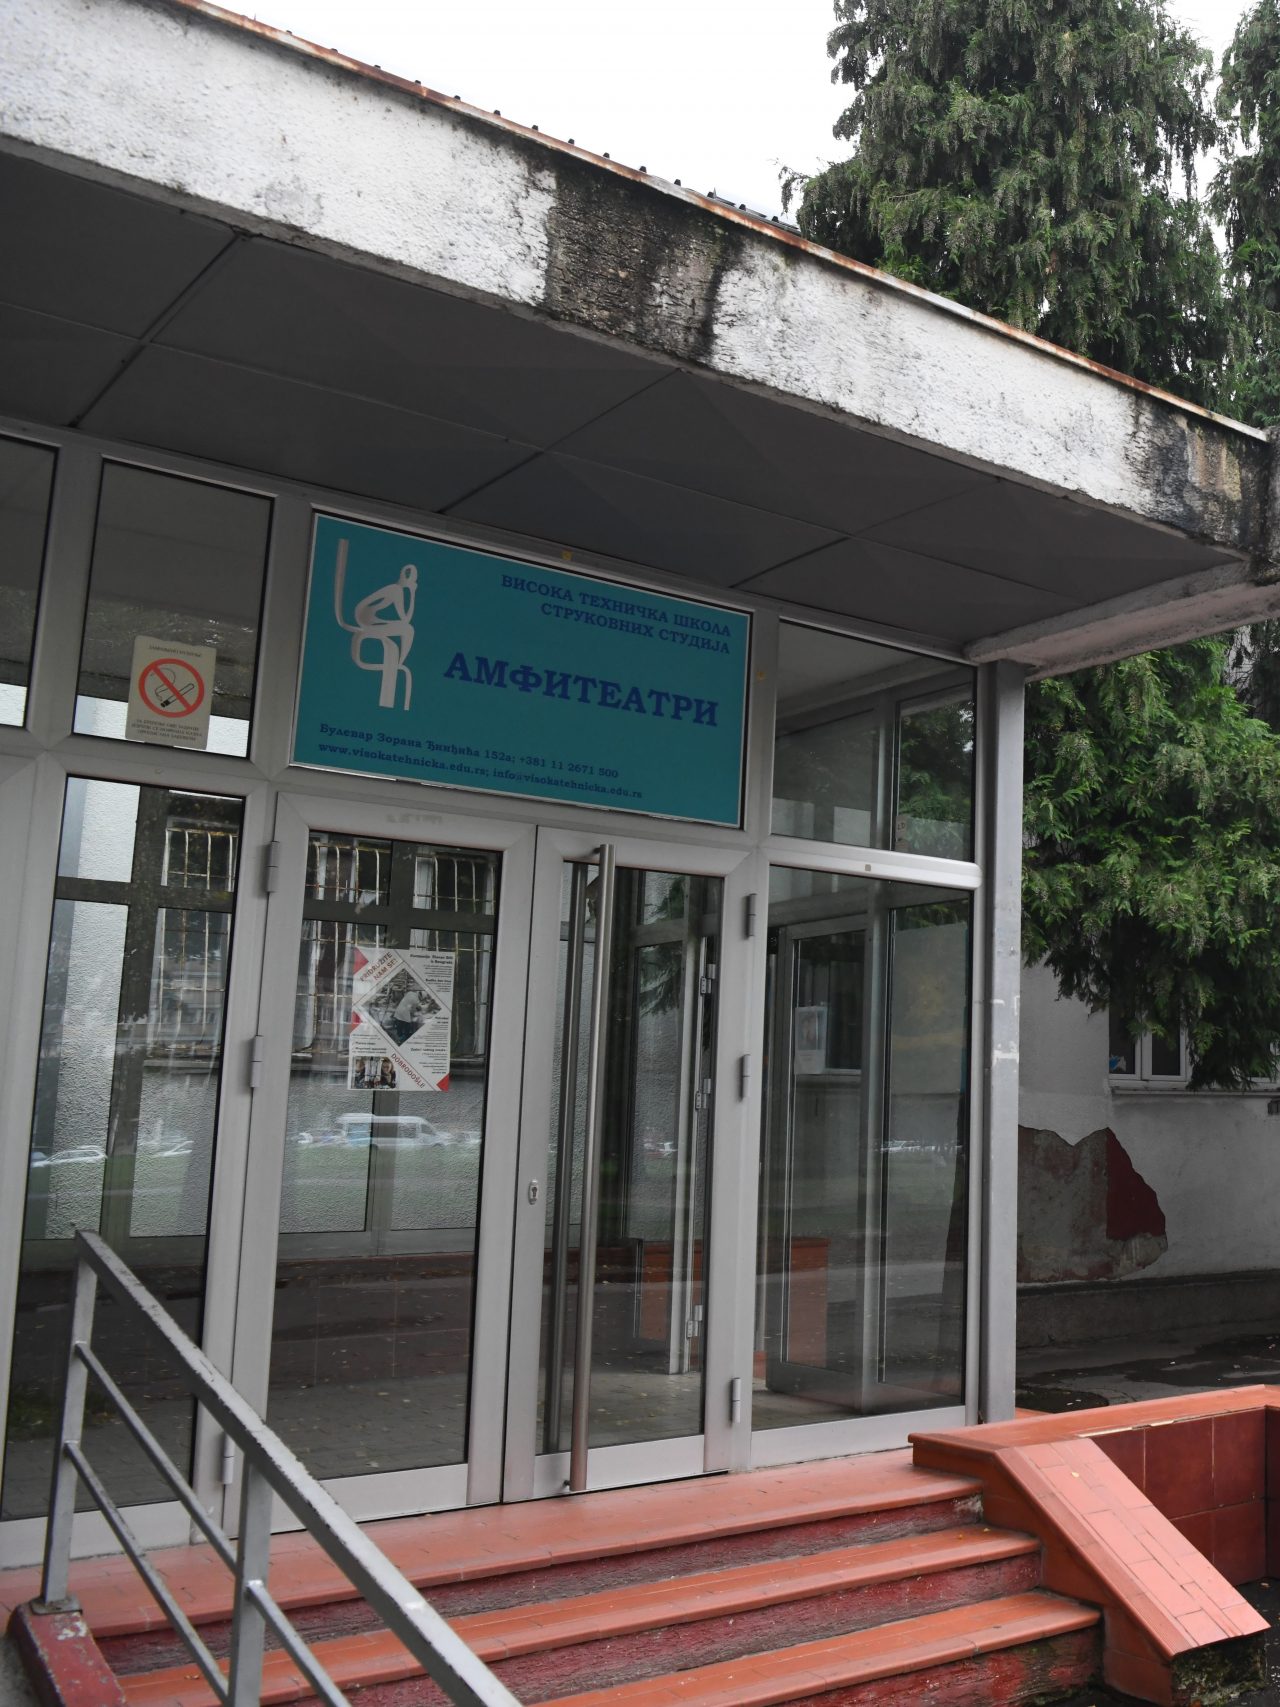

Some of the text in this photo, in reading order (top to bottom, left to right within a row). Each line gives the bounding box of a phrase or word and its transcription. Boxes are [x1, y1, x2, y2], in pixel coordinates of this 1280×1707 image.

[501, 574, 732, 637] ВИСОКА ТЕХНИЧКА ШКОЛА
[541, 603, 731, 654] СТРУКОВНИХ СТУДИЈА
[443, 651, 719, 727] АМФИТЕАТРИ
[318, 743, 643, 798] www.visokatehnicka.edu.rs; info@visokatehnicka.edu.rs
[320, 723, 373, 742] Булевар
[377, 732, 422, 748] Зорана
[520, 755, 546, 768] +381
[551, 760, 563, 770] 11
[568, 762, 594, 775] 2671
[598, 768, 619, 779] 500
